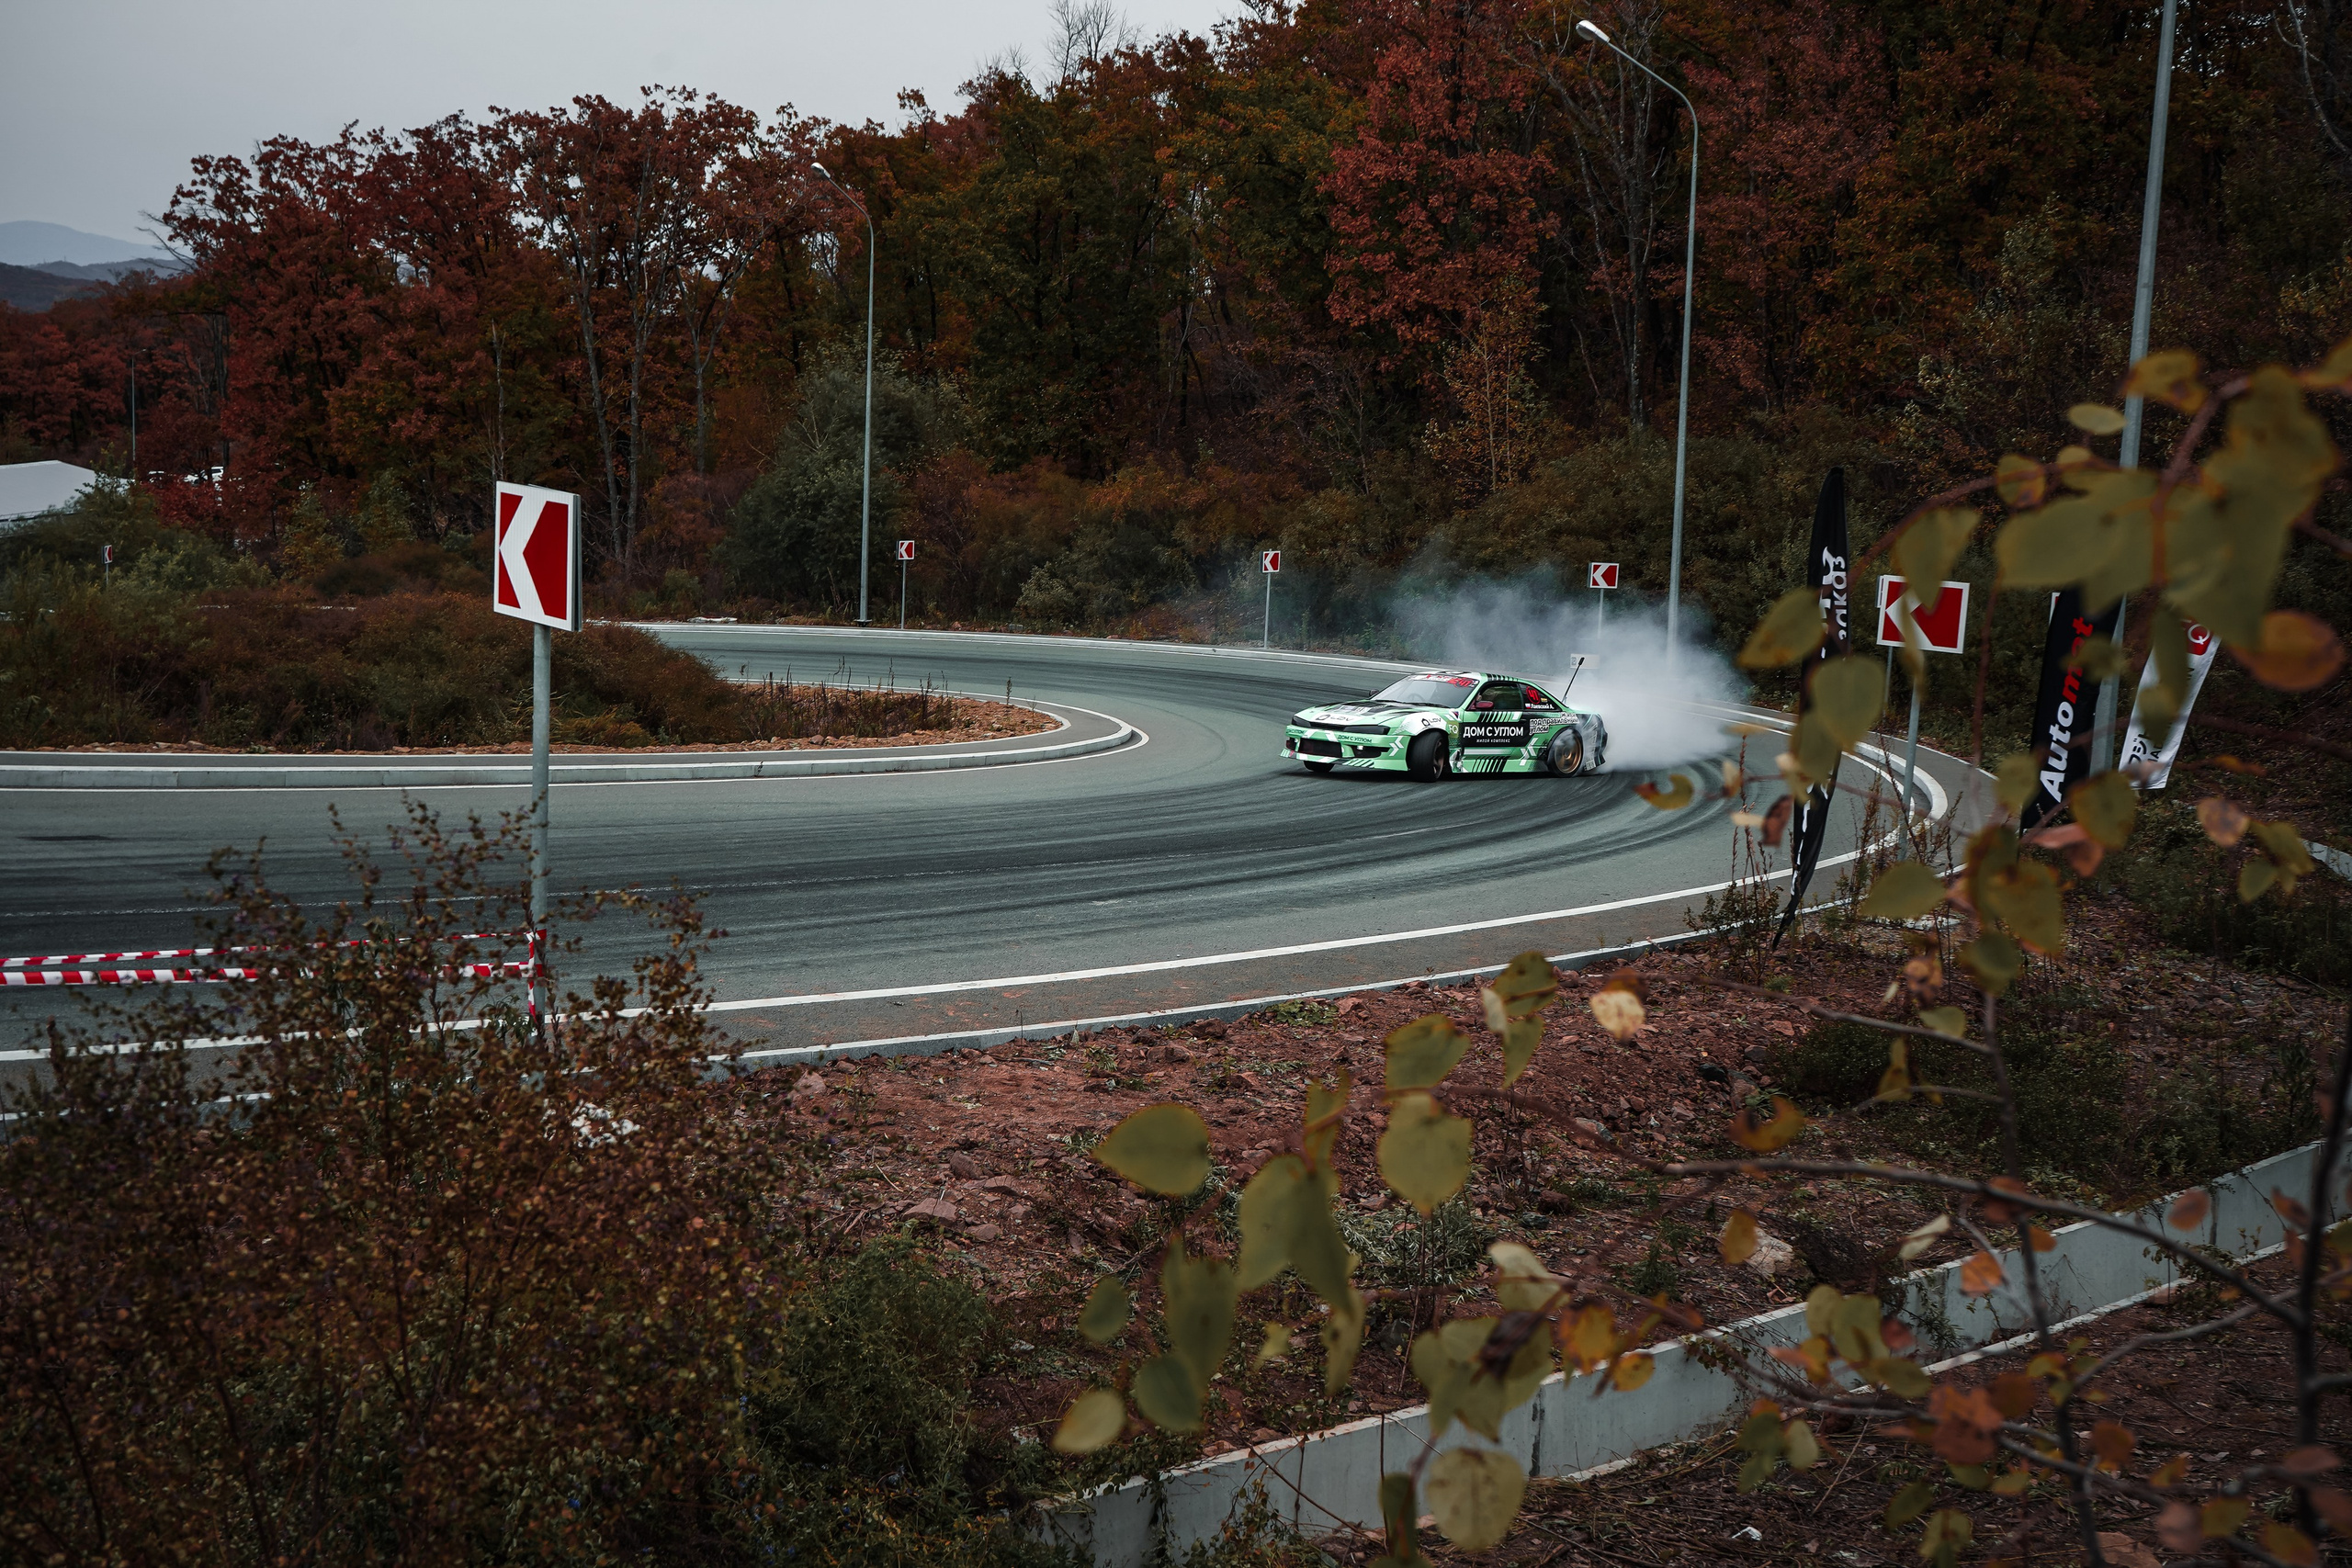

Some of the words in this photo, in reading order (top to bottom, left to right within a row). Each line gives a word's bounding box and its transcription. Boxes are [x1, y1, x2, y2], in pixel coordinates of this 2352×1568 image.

[1463, 727, 1485, 738] ДОМ
[1487, 727, 1493, 737] С
[1494, 727, 1523, 737] УГЛОМ
